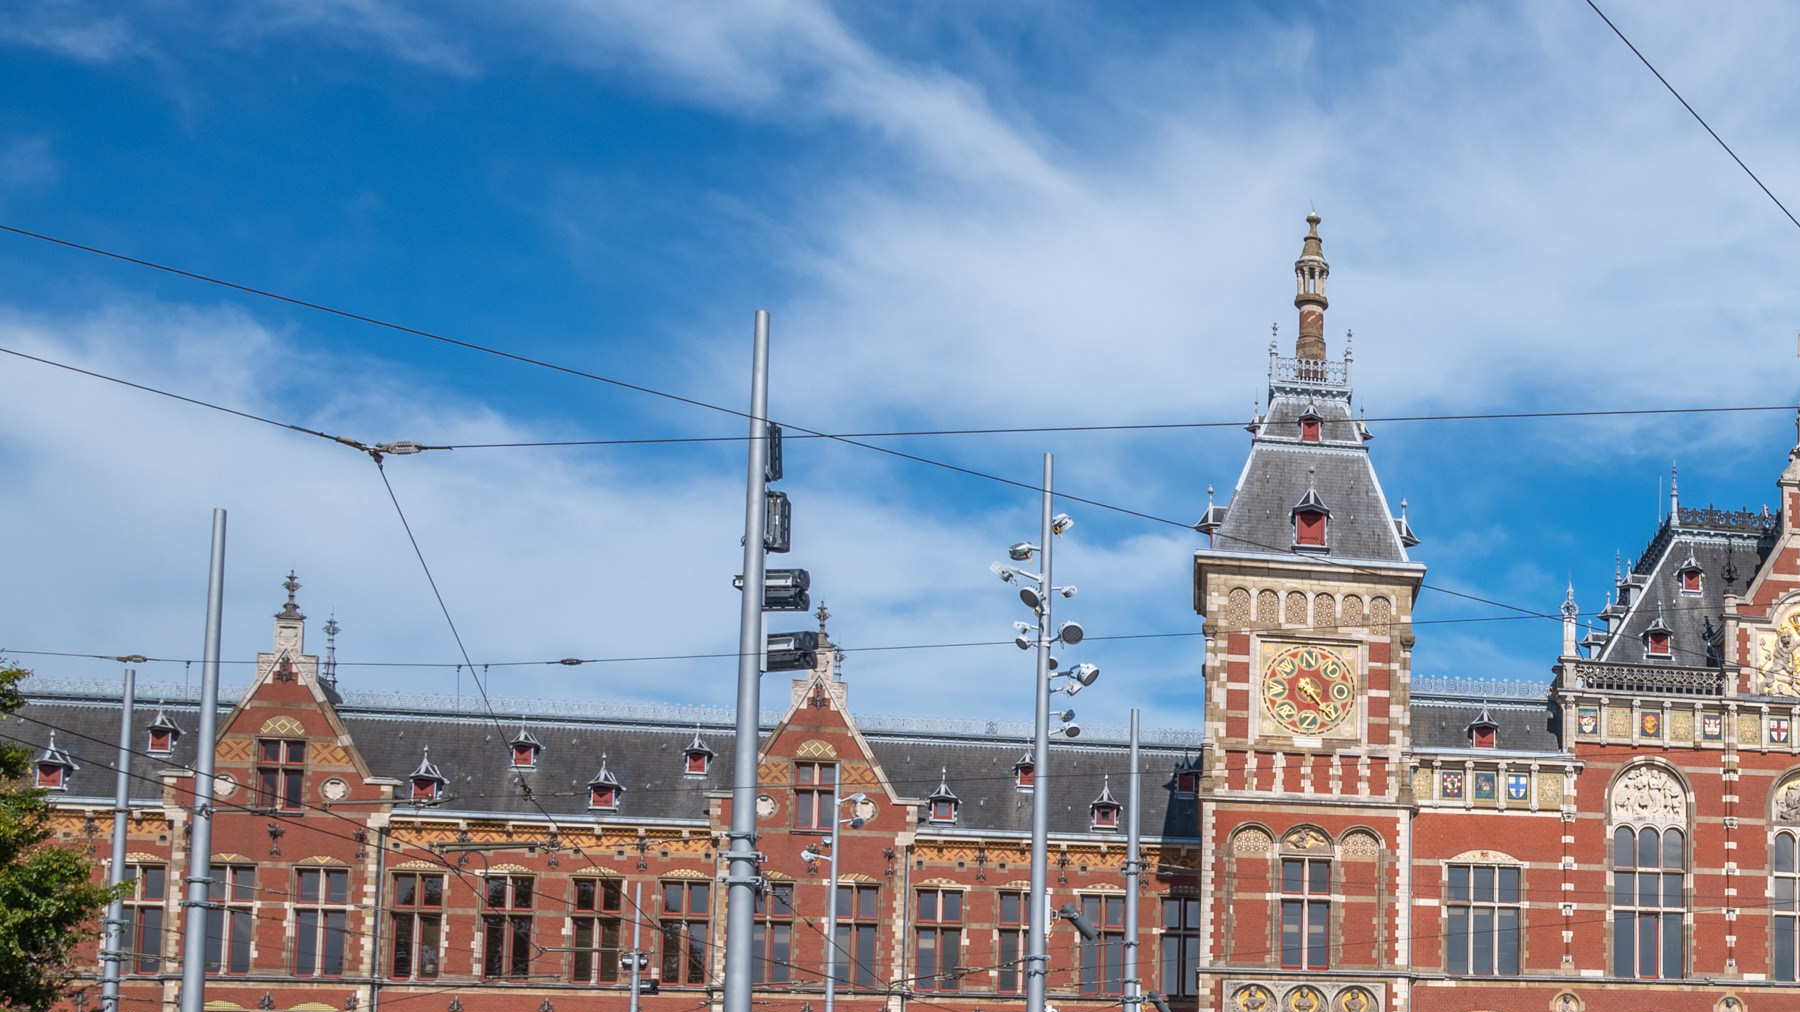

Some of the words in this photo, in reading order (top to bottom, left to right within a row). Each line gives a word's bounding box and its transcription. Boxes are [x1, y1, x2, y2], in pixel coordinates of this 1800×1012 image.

[1303, 652, 1316, 667] N
[1333, 684, 1348, 699] O
[1301, 713, 1315, 729] Z
